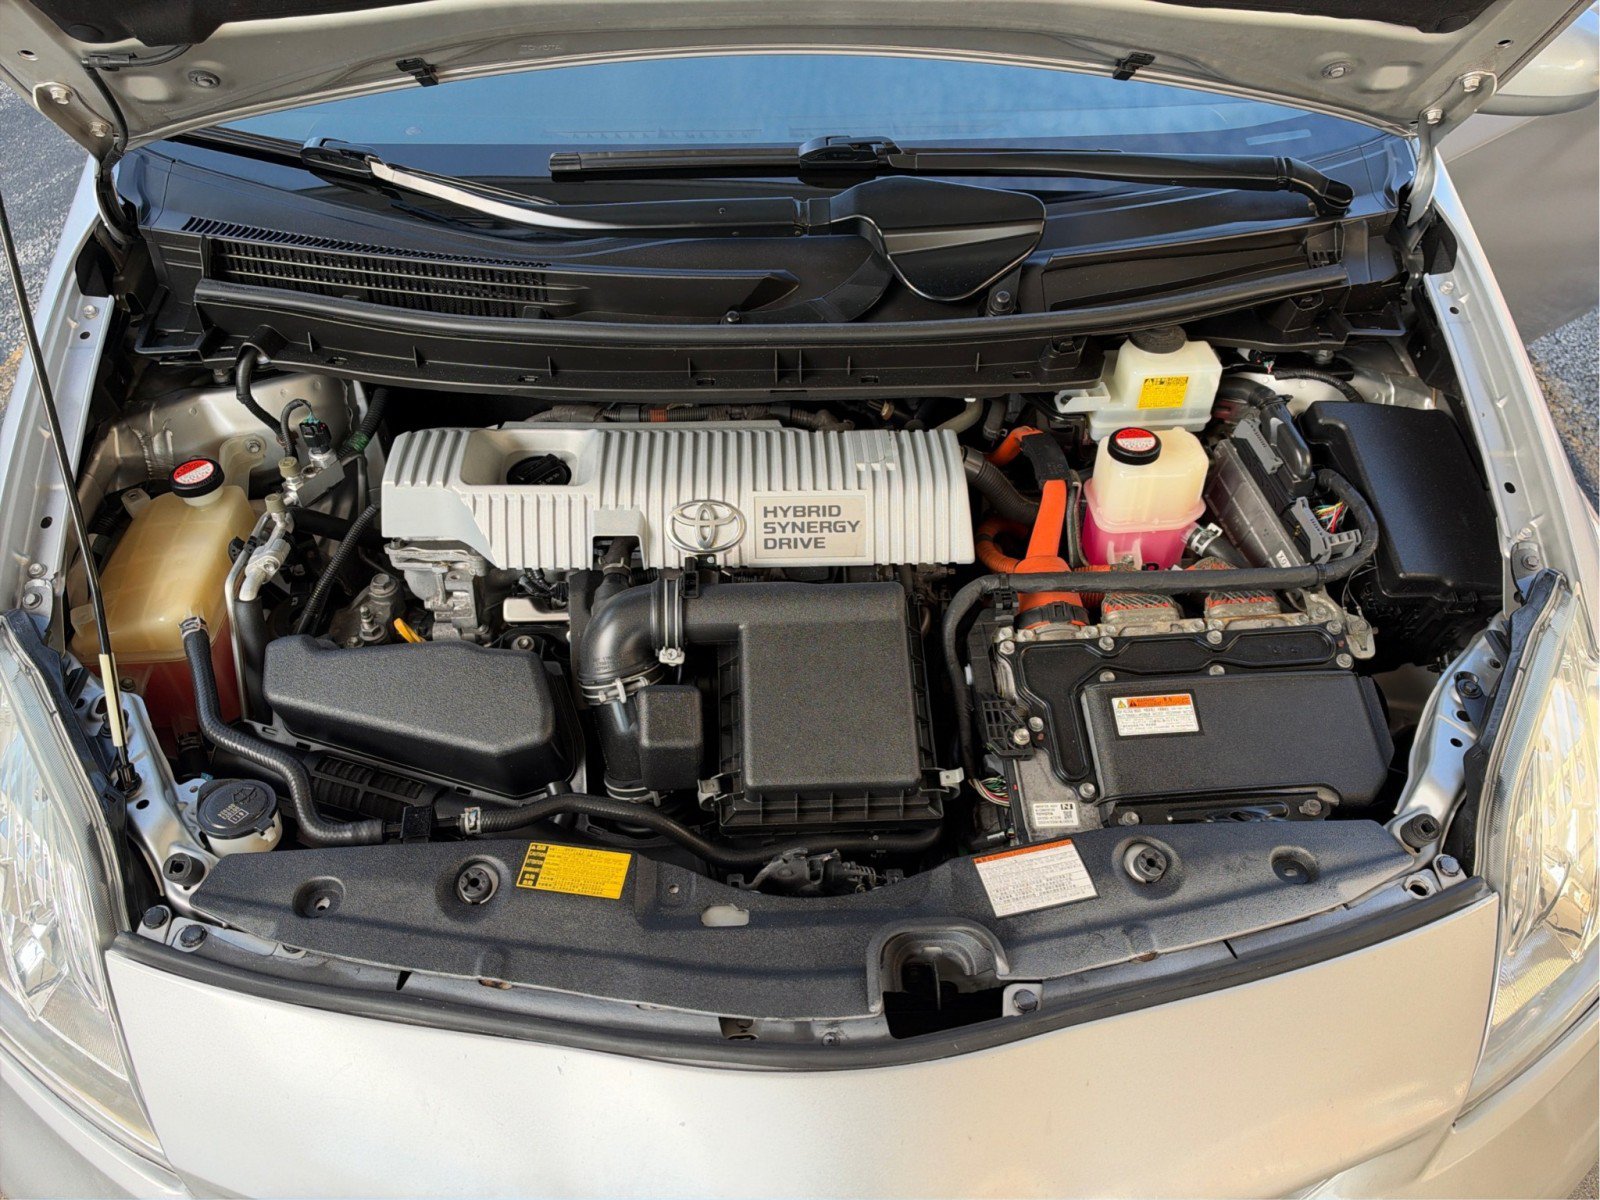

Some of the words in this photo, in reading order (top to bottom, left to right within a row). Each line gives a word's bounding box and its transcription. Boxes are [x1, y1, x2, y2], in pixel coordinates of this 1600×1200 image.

[763, 505, 842, 518] HYBRID
[763, 520, 861, 534] SYNERGY
[763, 537, 826, 550] DRIVE
